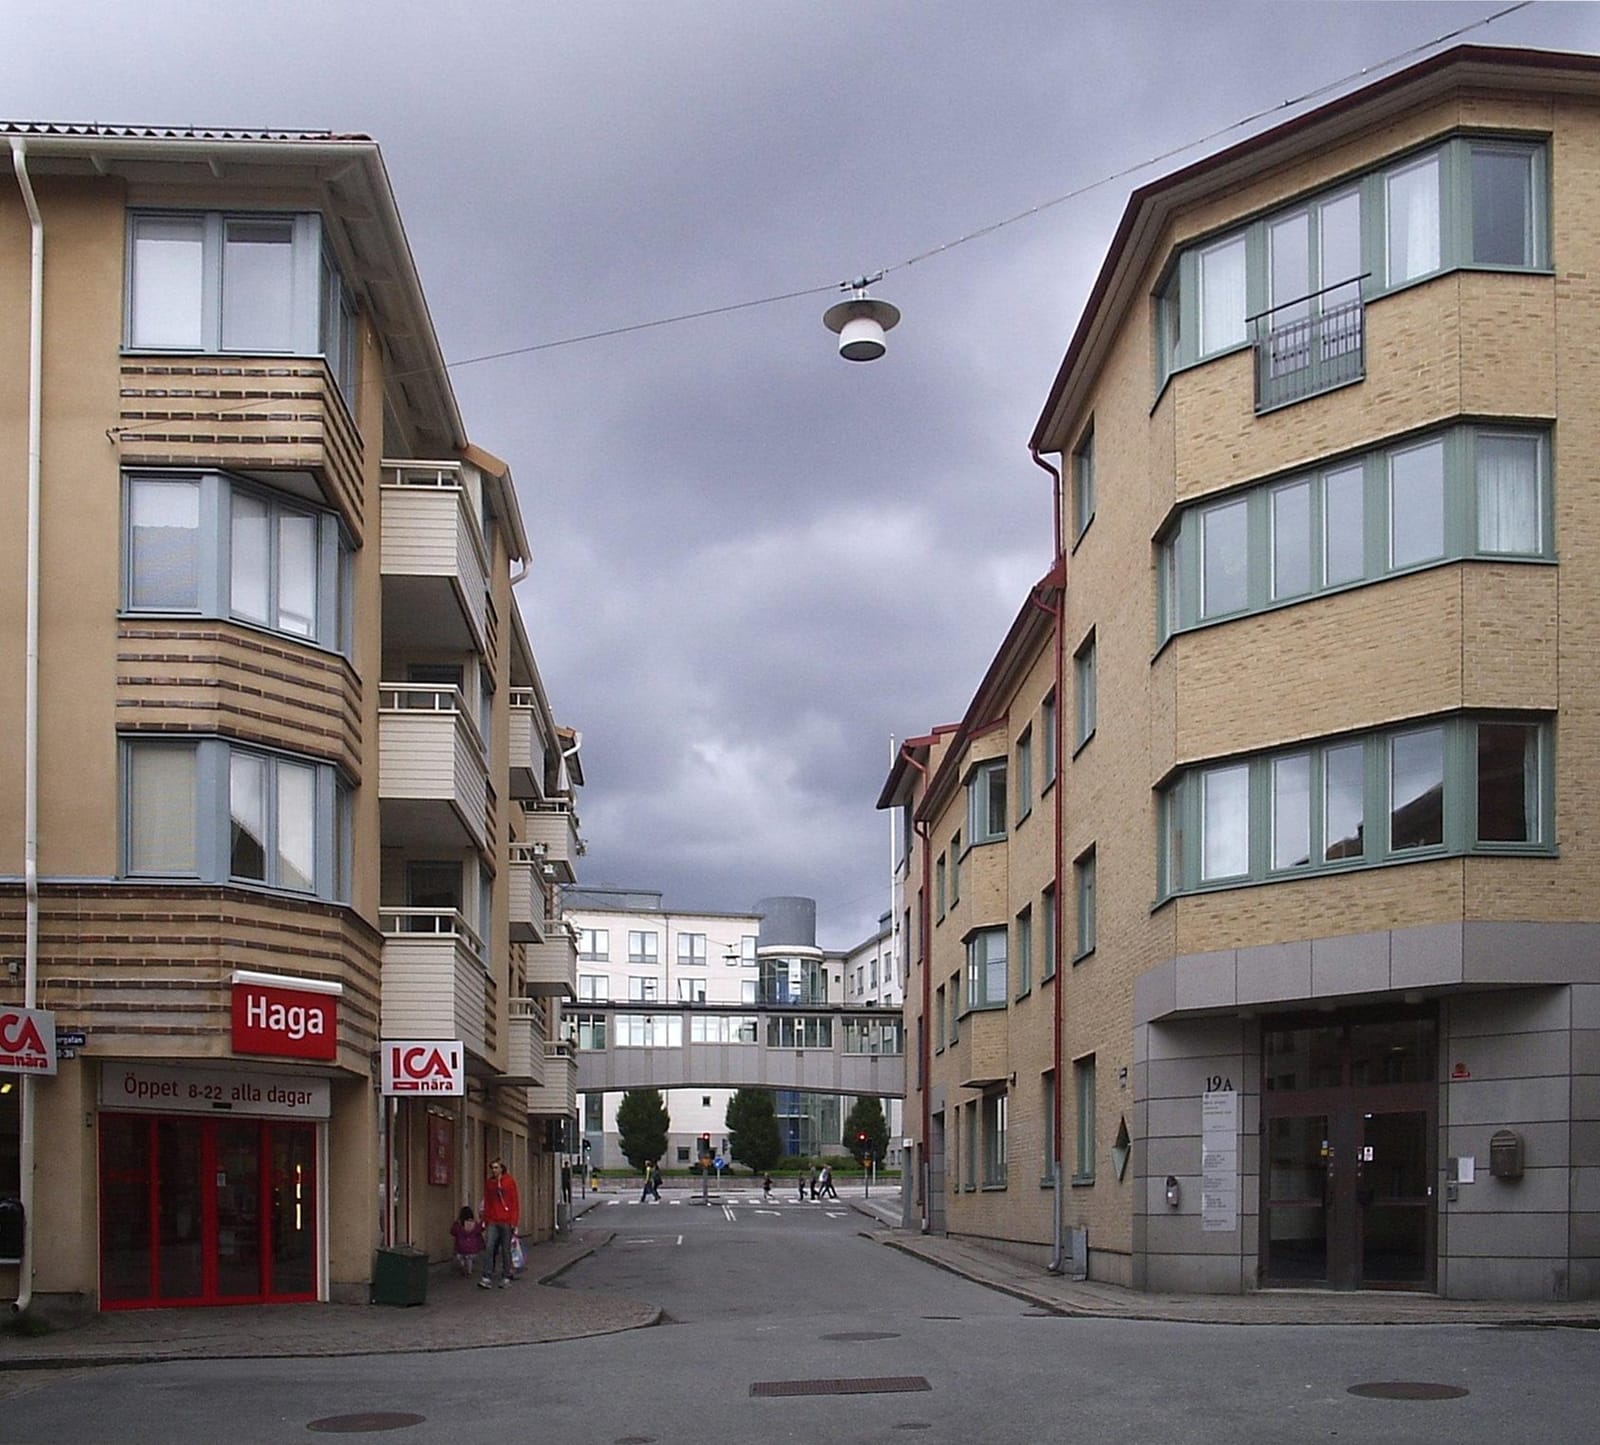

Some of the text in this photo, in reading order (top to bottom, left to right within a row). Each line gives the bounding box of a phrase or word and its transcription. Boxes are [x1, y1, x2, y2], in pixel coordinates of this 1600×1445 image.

[246, 994, 324, 1040] Haga
[0, 1013, 47, 1055] CA
[16, 1053, 48, 1068] nära
[392, 1047, 453, 1079] ICA
[124, 1072, 312, 1107] Öppet 8-22 alla dagar
[421, 1079, 453, 1091] nära
